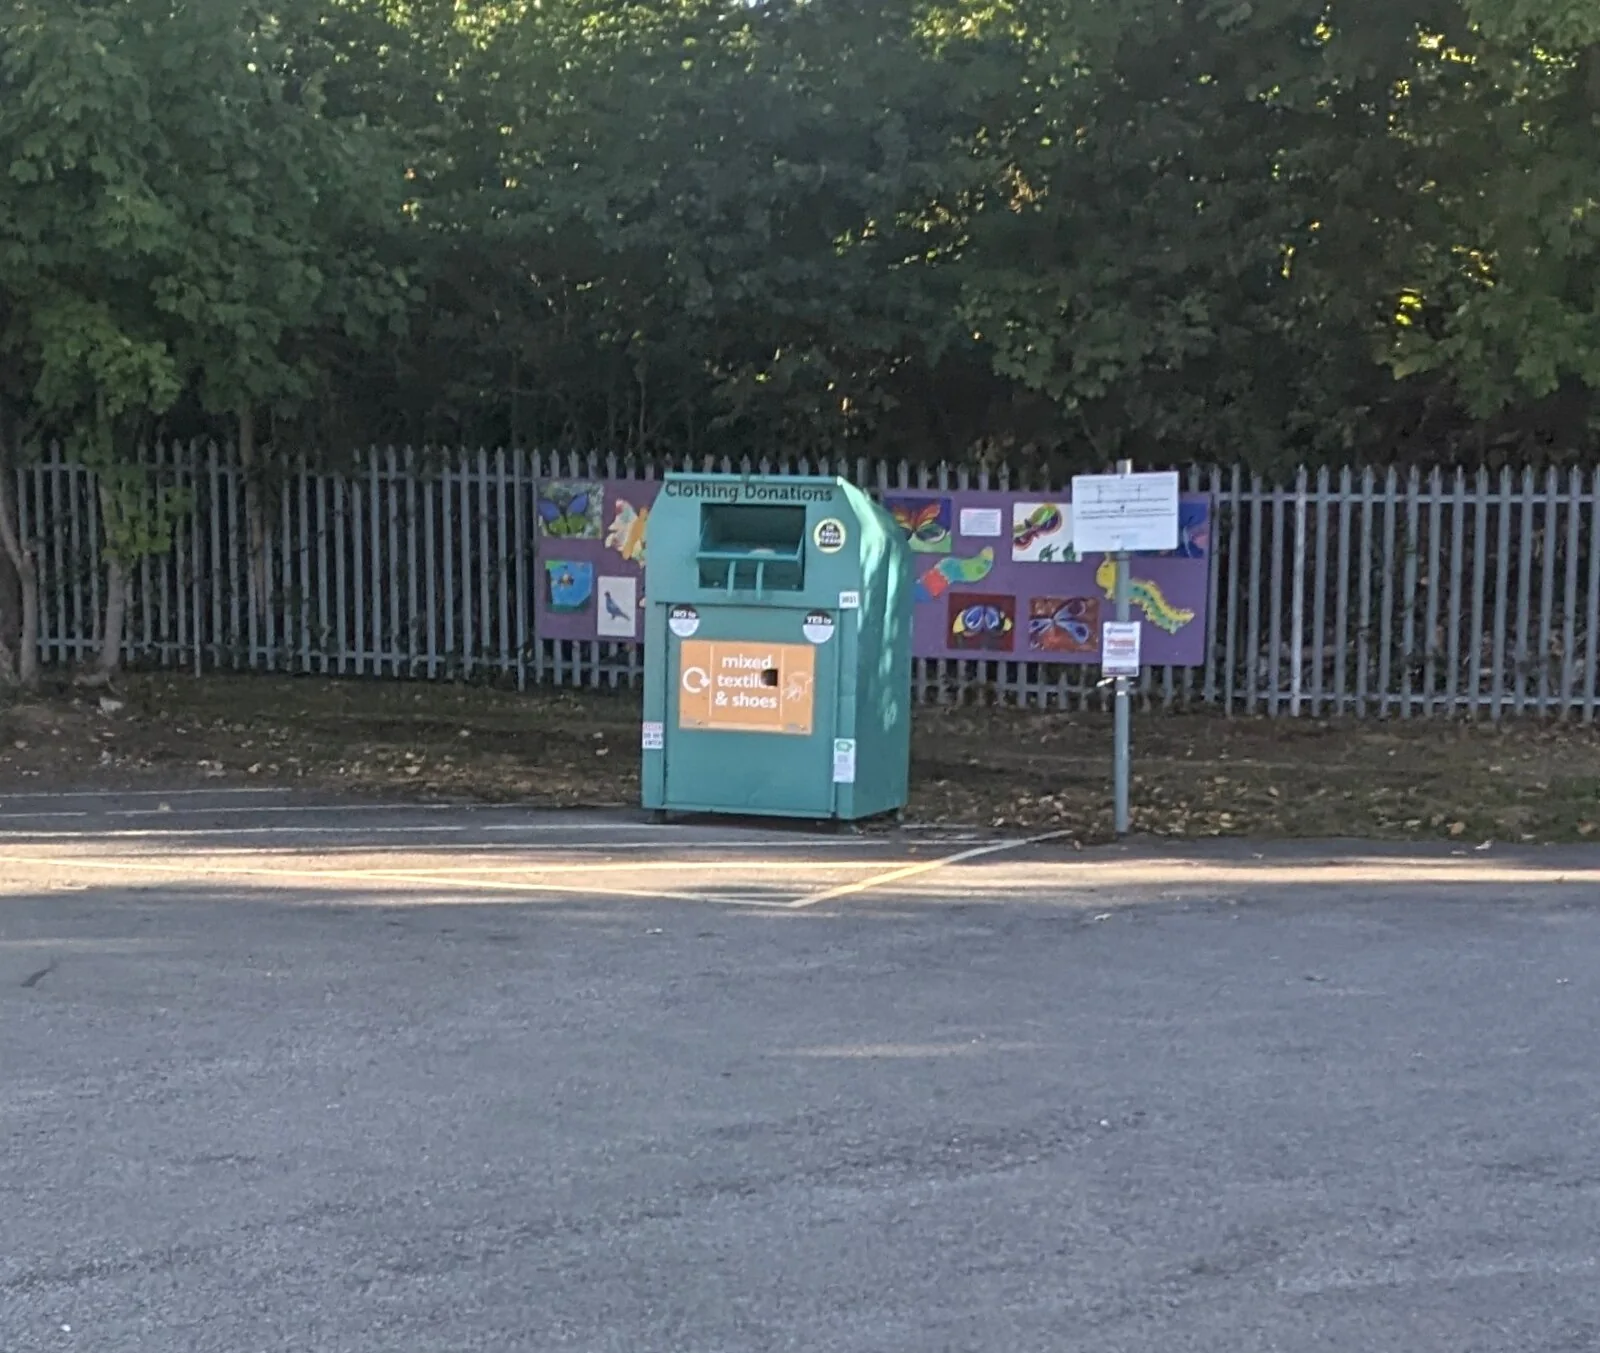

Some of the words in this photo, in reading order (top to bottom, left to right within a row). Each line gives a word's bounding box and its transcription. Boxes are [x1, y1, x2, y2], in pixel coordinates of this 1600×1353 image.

[664, 481, 740, 503] Clothing
[745, 484, 833, 502] Donations
[721, 653, 774, 669] mixed
[717, 672, 776, 689] textil
[715, 690, 728, 706] &
[732, 691, 778, 709] shoes
